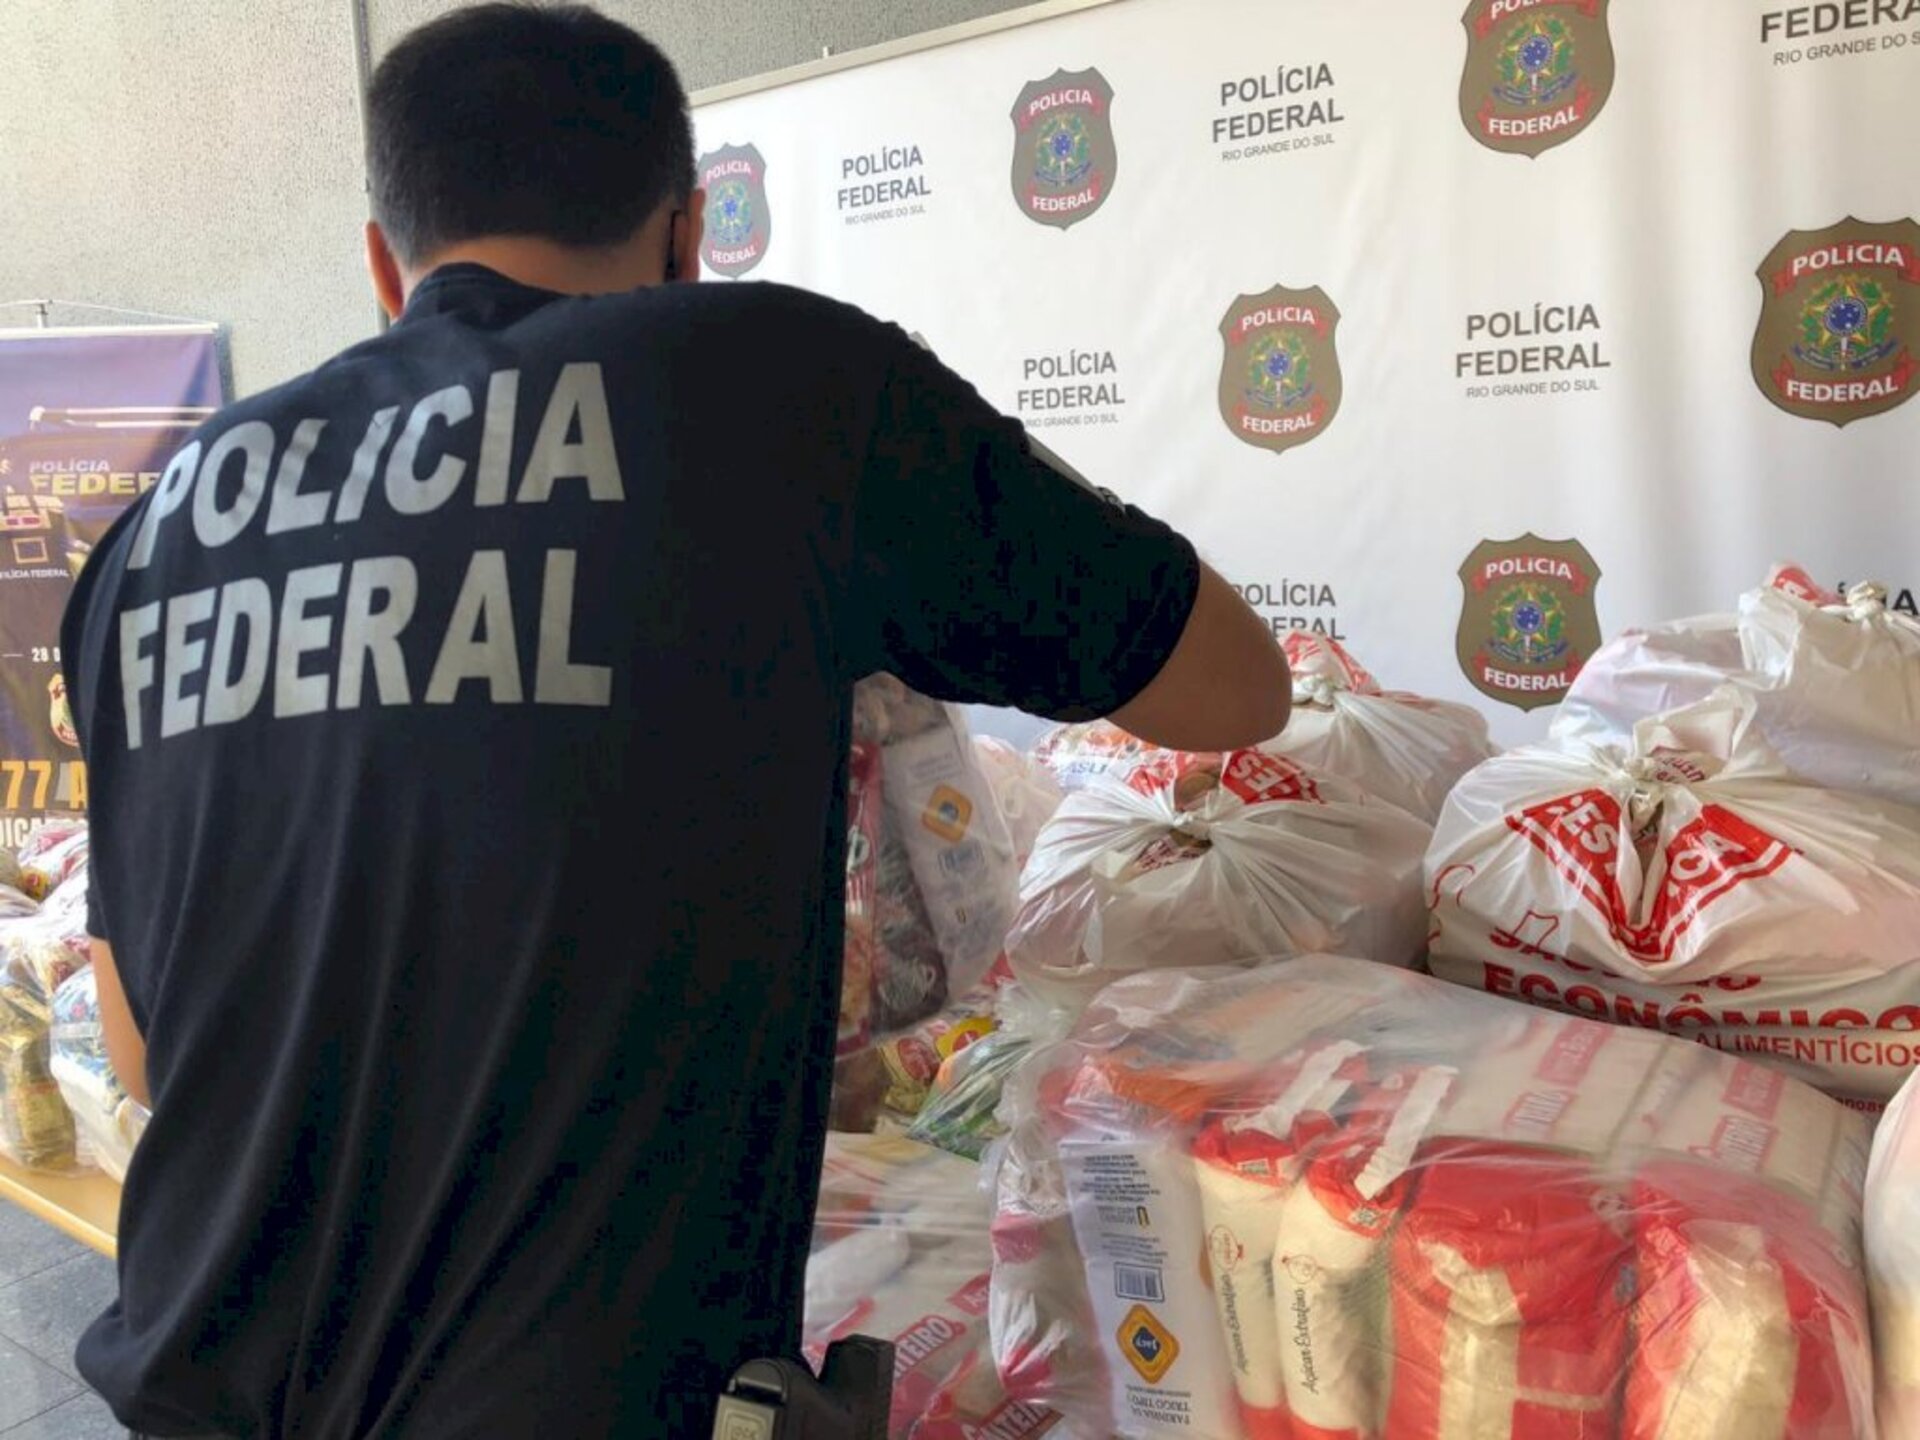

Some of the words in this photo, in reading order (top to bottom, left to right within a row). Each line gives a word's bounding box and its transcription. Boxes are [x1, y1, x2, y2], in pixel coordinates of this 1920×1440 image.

[1761, 0, 1920, 43] FEDERA
[1774, 50, 1802, 66] RIO
[1807, 37, 1876, 60] GRANDE
[1882, 33, 1906, 49] DO
[1221, 62, 1334, 106] POLÍCIA
[1212, 98, 1345, 143] FEDERAL
[1488, 106, 1580, 136] FEDERAL
[843, 145, 923, 179] POLÍCIA
[1222, 149, 1241, 162] RIO
[1243, 141, 1290, 159] GRANDE
[1293, 138, 1310, 151] DO
[1313, 133, 1334, 147] SUL
[838, 175, 931, 210] FEDERAL
[1032, 188, 1095, 212] FEDERAL
[711, 245, 756, 265] FEDERAL
[1467, 302, 1600, 341] POLÍCIA
[1023, 350, 1117, 380] POLÍCIA
[1456, 342, 1611, 378] FEDERAL
[1017, 383, 1125, 411] FEDERAL
[1466, 386, 1489, 398] RIO
[1492, 382, 1547, 396] GRANDE
[1550, 380, 1571, 393] DO
[1573, 379, 1600, 391] SUL
[1786, 375, 1898, 402] FEDERAL
[1242, 413, 1315, 434] FEDERAL
[29, 472, 162, 495] FEDER
[31, 647, 48, 662] 28
[119, 548, 613, 750] FEDERAL
[1484, 666, 1571, 691] FEDERAL
